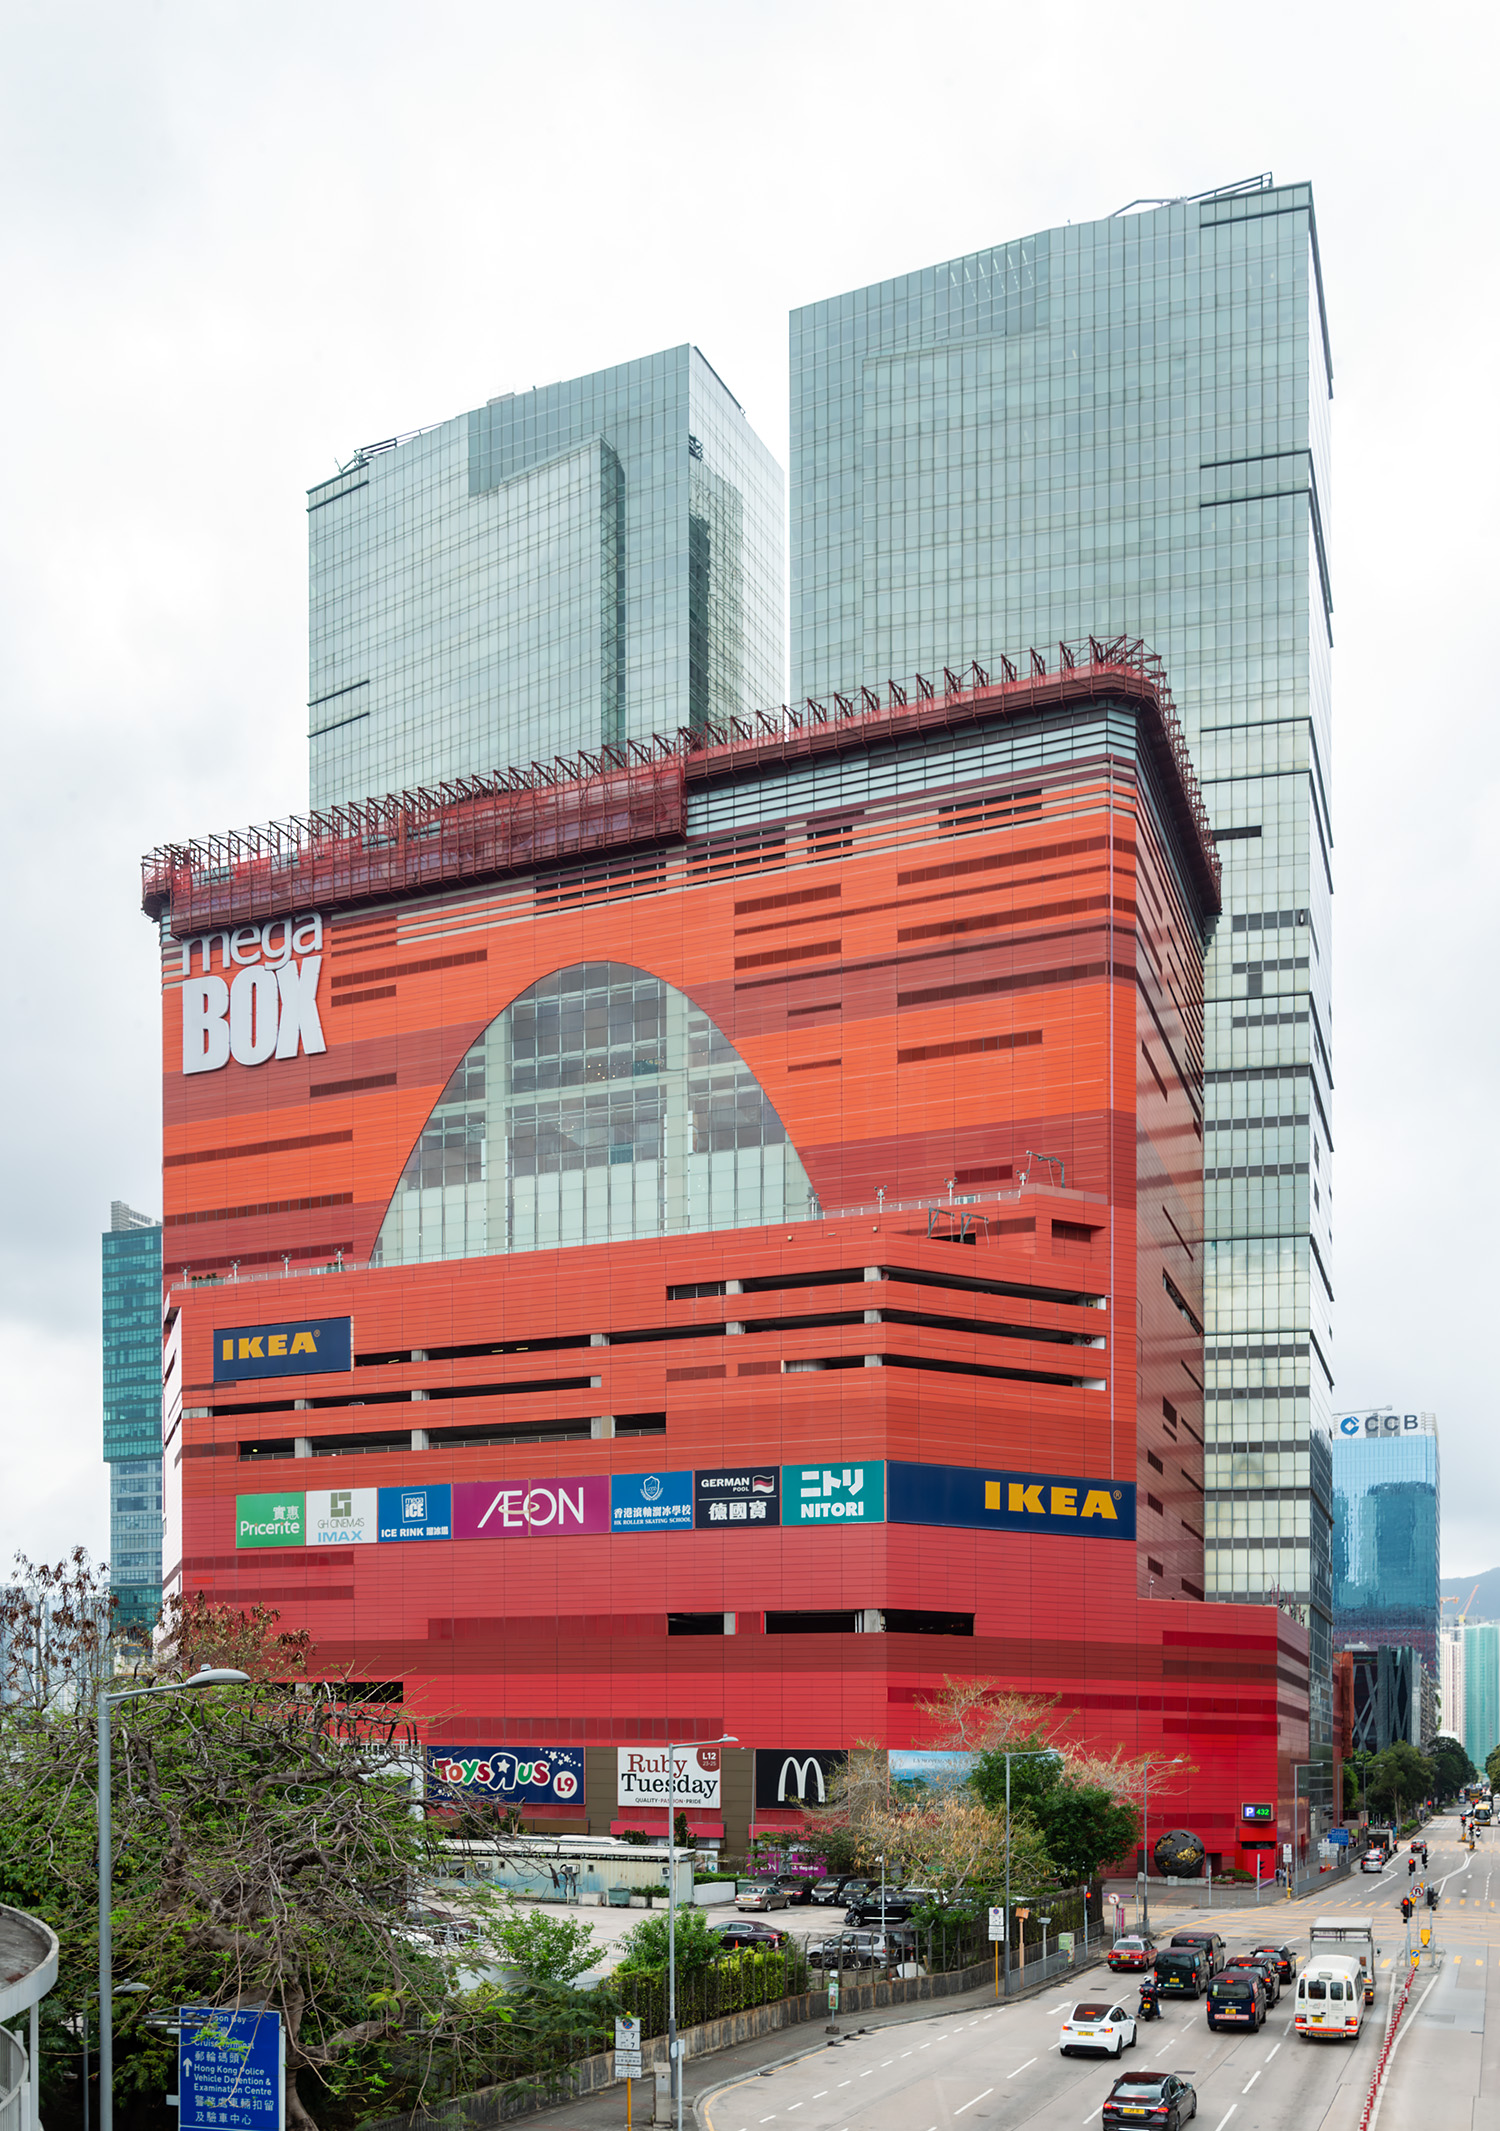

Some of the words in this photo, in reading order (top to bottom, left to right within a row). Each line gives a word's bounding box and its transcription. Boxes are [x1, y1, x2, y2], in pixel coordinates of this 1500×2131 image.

[182, 912, 323, 976] mega
[182, 955, 327, 1075] BOX
[222, 1330, 318, 1361] IKEA
[1364, 1414, 1419, 1432] CCB
[700, 1477, 750, 1488] GERMAN
[800, 1469, 864, 1498] ニトリ
[984, 1480, 1119, 1520] IKEA
[272, 1505, 300, 1520] 實惠
[800, 1501, 864, 1518] NITORI
[240, 1521, 300, 1536] Pricerite
[330, 1517, 365, 1529] CINEMAS
[318, 1530, 363, 1543] IMAX
[381, 1528, 398, 1538] ICE
[399, 1527, 425, 1537] RINK
[702, 1752, 717, 1760] L12
[627, 1753, 688, 1779] Ruby
[557, 1777, 575, 1792] L9
[621, 1773, 719, 1799] Tuesday
[1256, 1808, 1270, 1816] 432
[194, 2050, 240, 2064] 郵輪碼頭
[194, 2063, 216, 2075] Hong
[216, 2065, 238, 2076] Kong
[240, 2067, 265, 2076] Police
[194, 2073, 222, 2083] Vehicle
[265, 2078, 272, 2086] &
[193, 2082, 243, 2094] Examination
[244, 2086, 272, 2096] Centre
[195, 2111, 252, 2126] 及驗車中心
